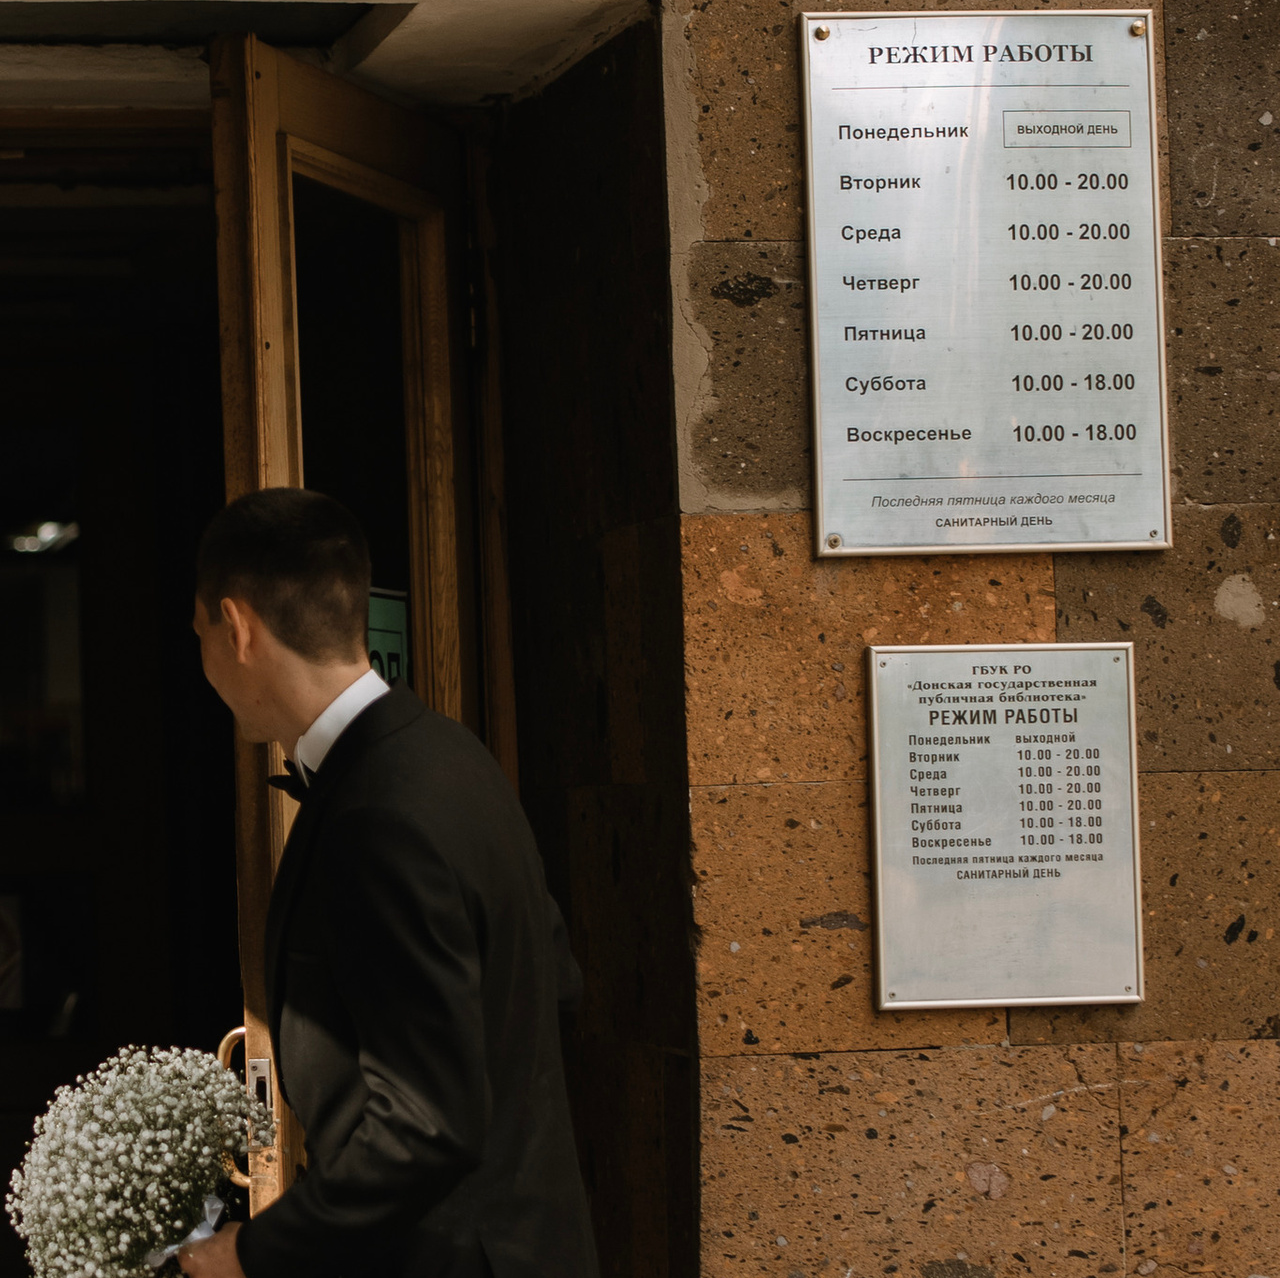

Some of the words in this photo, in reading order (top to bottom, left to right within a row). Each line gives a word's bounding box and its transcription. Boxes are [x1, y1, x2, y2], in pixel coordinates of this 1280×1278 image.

[868, 45, 974, 65] РЕЖИМ
[983, 44, 1094, 63] РАБОТЫ
[838, 124, 969, 142] Понедельник
[1017, 123, 1084, 136] ВЫХОДНОЙ
[1086, 124, 1118, 136] ДЕНЬ
[839, 175, 921, 194] Вторник
[1006, 173, 1058, 191] 10.00
[1077, 173, 1129, 190] 20.00
[841, 225, 901, 244] Среда
[1007, 223, 1060, 241] 10.00
[1078, 223, 1130, 240] 20.00
[842, 275, 921, 294] Четверг
[1009, 273, 1061, 291] 10.00
[1080, 273, 1132, 291] 20.00
[844, 325, 926, 343] Пятница
[1010, 324, 1063, 342] 10.00
[1081, 323, 1134, 341] 20.00
[845, 375, 927, 396] Суббота
[1011, 374, 1064, 392] 10.00
[1083, 373, 1135, 391] 18.00
[847, 427, 972, 446] Воскресенье
[1013, 424, 1065, 443] 10.00
[1085, 423, 1137, 441] 18.00
[871, 494, 944, 508] Последняя
[946, 495, 1006, 507] пятница
[1009, 492, 1065, 505] каждого
[1067, 494, 1116, 505] месяца
[935, 515, 1018, 528] САНИТАРНЫЙ
[1020, 516, 1053, 528] ДЕНЬ
[972, 665, 1009, 675] ГБУК
[1013, 664, 1032, 675] РО
[907, 680, 972, 692] «Донская
[977, 679, 1097, 692] государственная
[918, 692, 994, 707] публичная
[998, 691, 1087, 703] библиотека»
[929, 709, 997, 726] РЕЖИМ
[1004, 707, 1078, 725] РАБОТЫ
[908, 734, 991, 747] Понедельник
[1015, 731, 1076, 745] выходной
[909, 751, 960, 765] Вторник
[1016, 748, 1052, 761] 10.00
[1065, 748, 1100, 760] 20.00
[909, 768, 947, 782] Среда
[1017, 765, 1053, 778] 10.00
[1065, 764, 1101, 777] 20.00
[909, 785, 961, 799] Четверг
[1018, 783, 1053, 795] 10.00
[1066, 781, 1101, 794] 20.00
[910, 802, 963, 815] Пятница
[1019, 799, 1054, 812] 10.00
[1067, 798, 1102, 811] 20.00
[911, 818, 962, 834] Суббота
[1019, 816, 1055, 829] 10.00
[1067, 815, 1103, 828] 18.00
[911, 836, 992, 850] Воскресенье
[1020, 833, 1055, 846] 10.00
[1068, 832, 1103, 845] 18.00
[912, 855, 969, 866] Последняя
[972, 855, 1015, 865] пятница
[1018, 854, 1062, 864] каждого
[1064, 853, 1104, 862] месяца
[956, 868, 1030, 880] САНИТАРНЫЙ
[1032, 868, 1061, 879] ДЕНЬ
